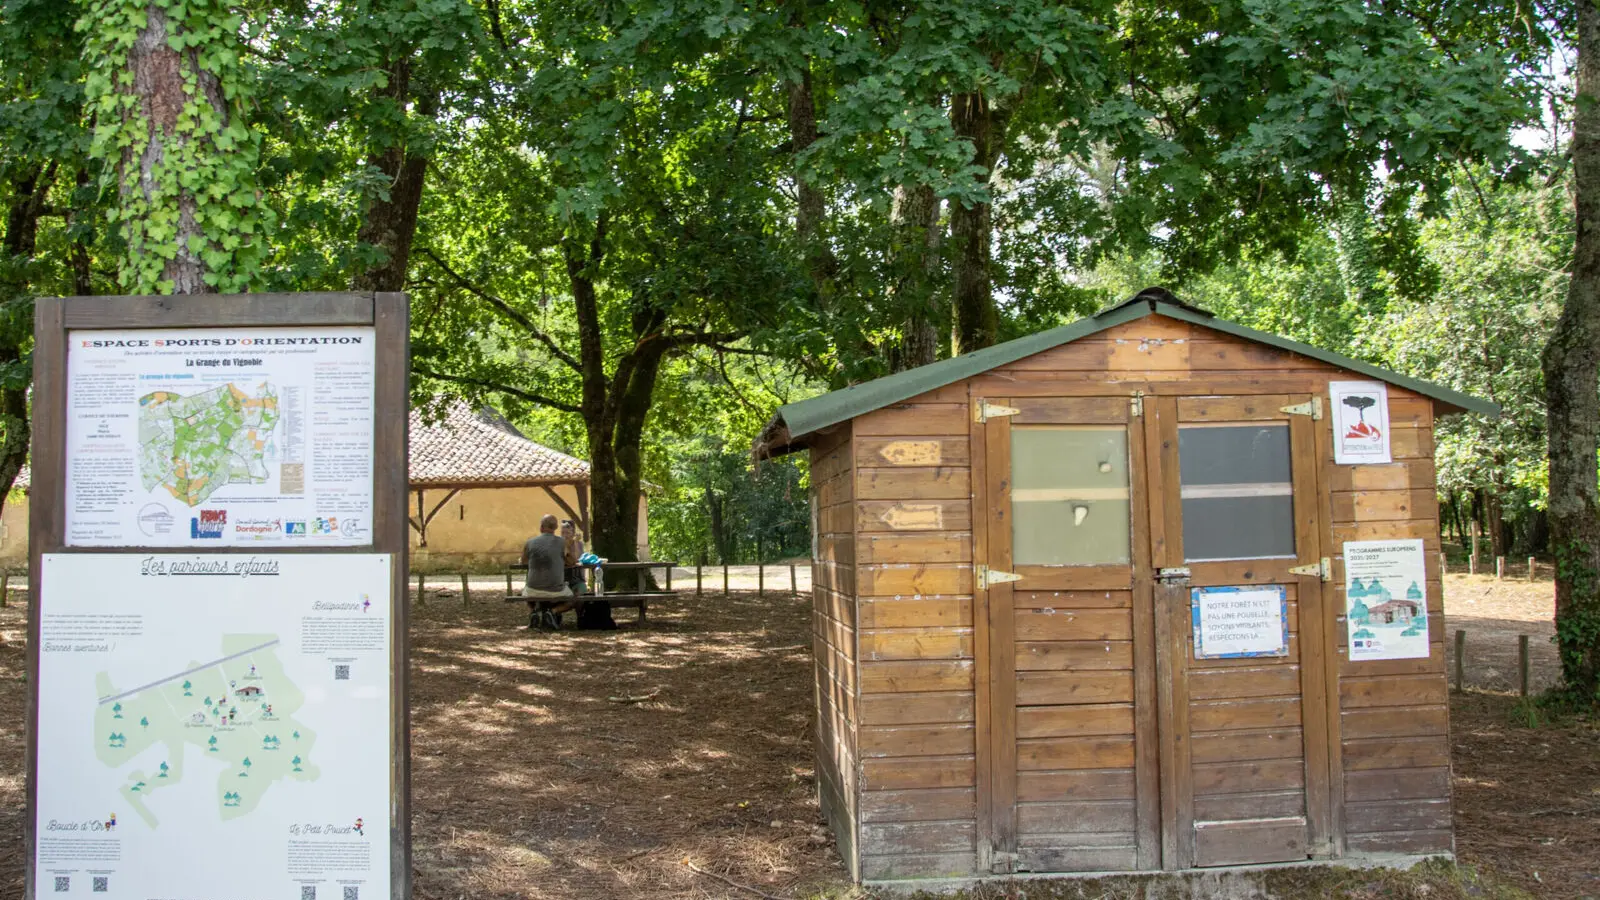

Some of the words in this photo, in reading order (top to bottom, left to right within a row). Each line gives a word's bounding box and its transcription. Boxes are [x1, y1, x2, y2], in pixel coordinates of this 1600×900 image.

[81, 339, 149, 348] ESPACE
[153, 338, 222, 347] SPORTS
[225, 336, 362, 346] D'ORIENTATION
[185, 358, 194, 367] La
[196, 358, 220, 368] Grange
[222, 358, 231, 366] du
[233, 357, 263, 367] Vignoble
[235, 525, 273, 534] Dordogne
[141, 556, 165, 576] Les
[168, 560, 228, 577] parcours
[234, 556, 280, 578] enfants
[1207, 602, 1229, 610] NOTRE
[1208, 633, 1250, 641] RESPECTONS
[46, 819, 79, 832] Boucle
[289, 823, 300, 835] Le
[302, 823, 321, 834] Petit
[324, 823, 352, 834] Poucet
